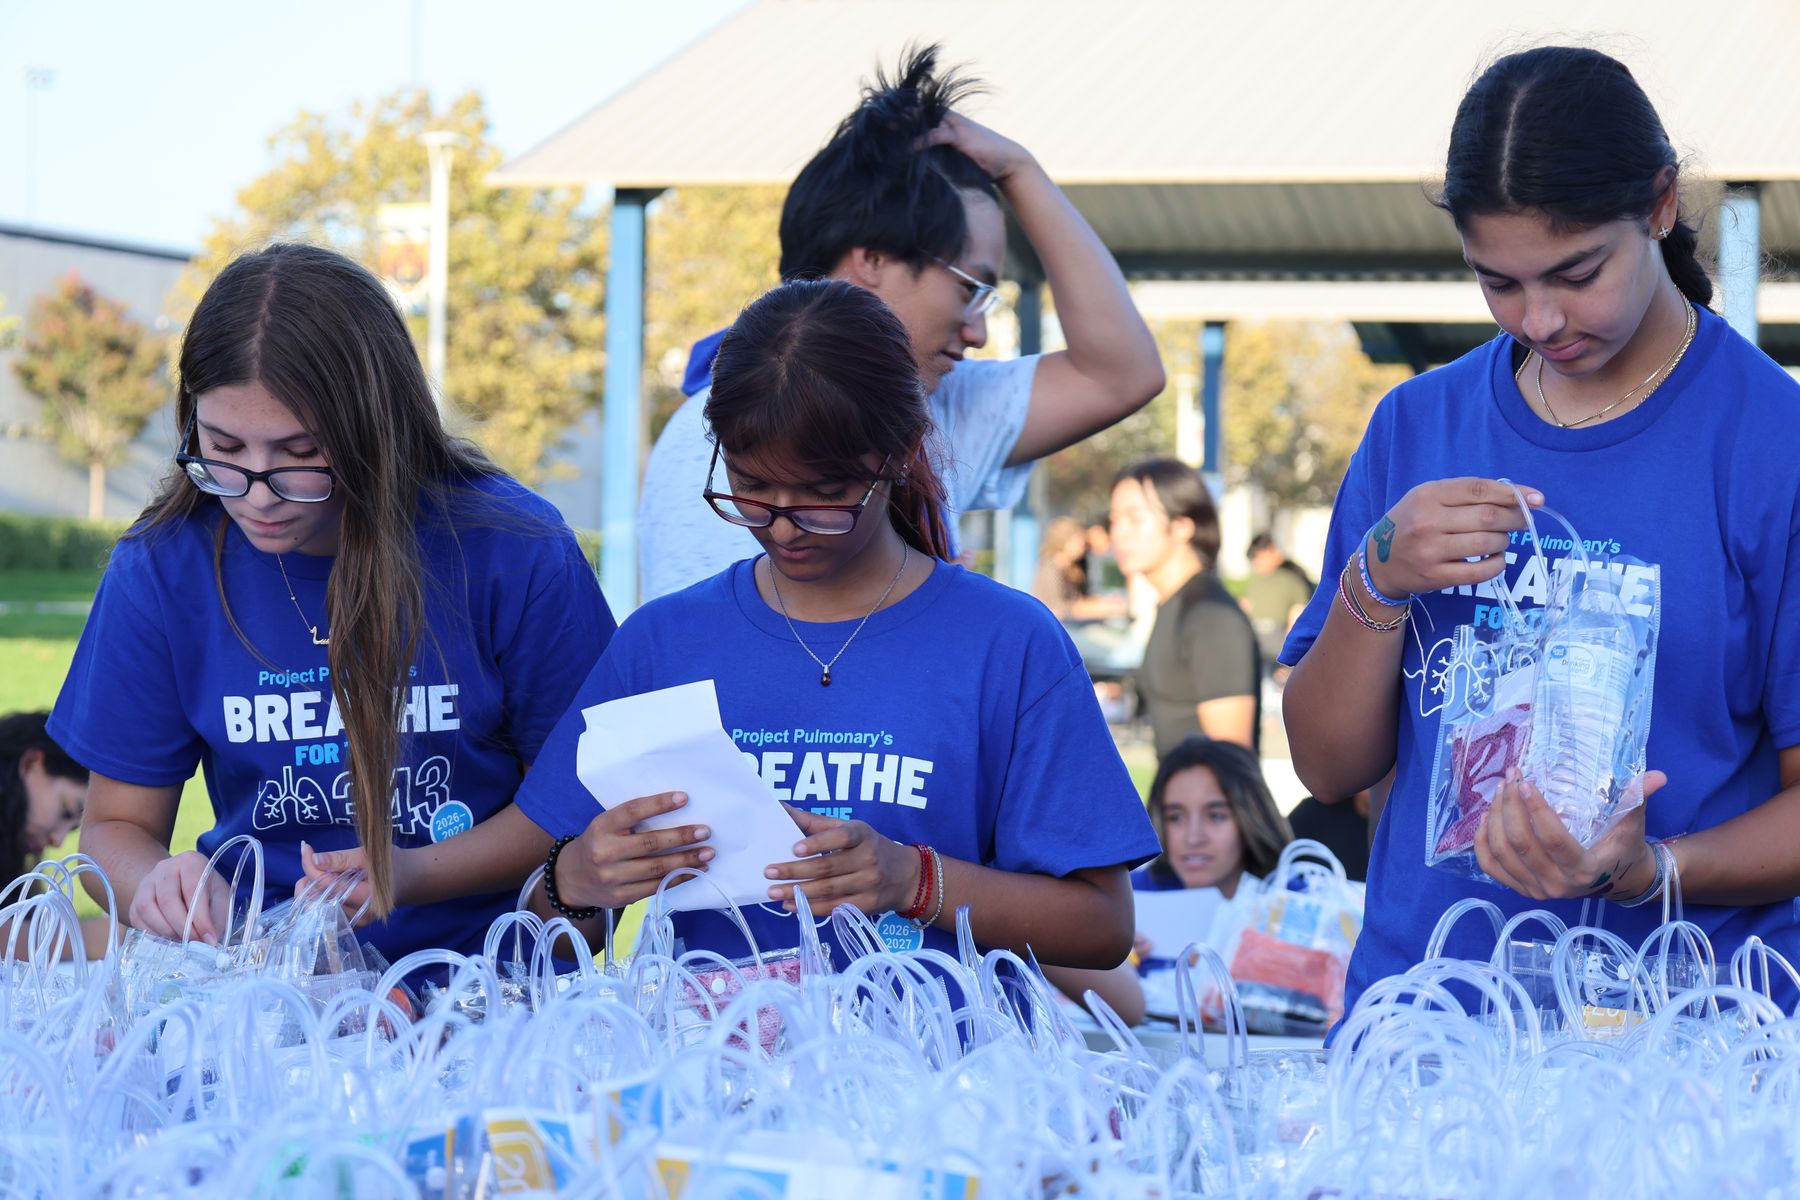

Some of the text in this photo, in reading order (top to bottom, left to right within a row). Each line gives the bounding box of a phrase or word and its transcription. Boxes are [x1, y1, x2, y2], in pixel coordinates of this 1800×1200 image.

[1521, 531, 1621, 555] Pulmoary's
[258, 668, 315, 688] Project
[223, 683, 460, 743] BREAHE
[732, 729, 894, 748] Project Pulmonary's
[295, 742, 340, 766] FOR
[741, 751, 934, 810] EATHE
[441, 823, 465, 840] 2027
[885, 937, 912, 950] 2027
